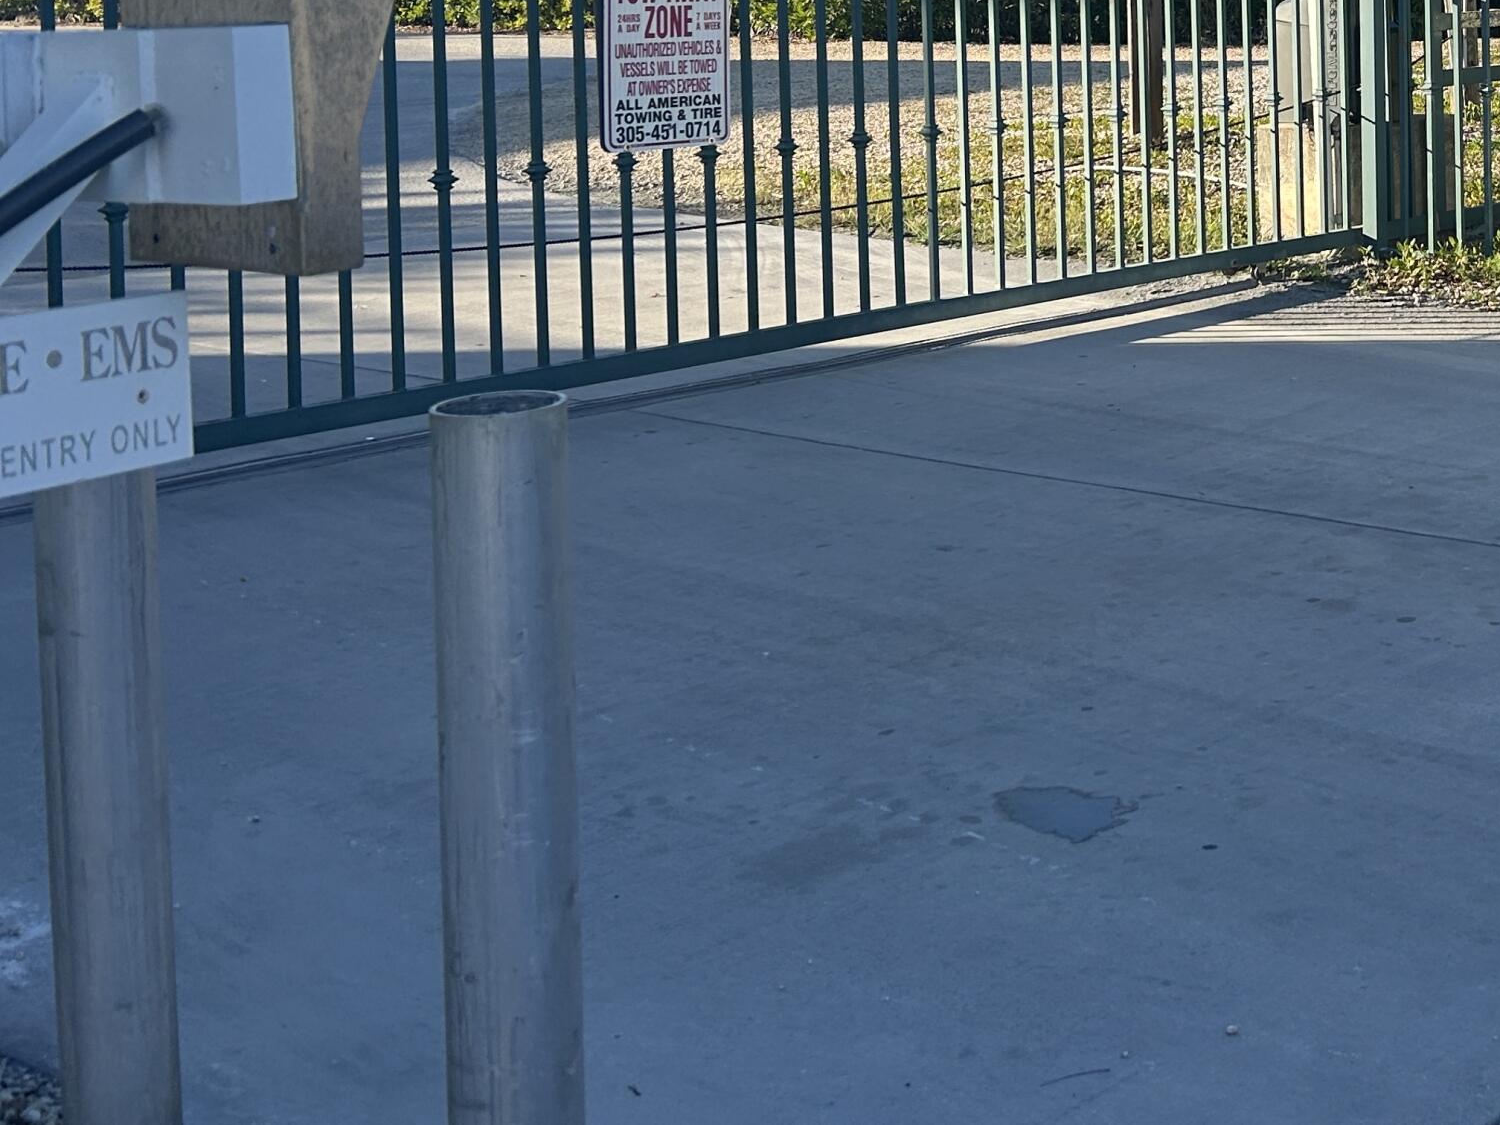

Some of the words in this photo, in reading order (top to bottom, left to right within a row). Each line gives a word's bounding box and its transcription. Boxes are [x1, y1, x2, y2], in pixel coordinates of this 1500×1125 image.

[617, 13, 641, 23] 24HRS
[644, 5, 693, 39] ZONE
[696, 12, 701, 21] 7
[703, 11, 721, 21] DAYS
[617, 24, 623, 33] A
[626, 24, 640, 33] DAY
[696, 22, 701, 30] A
[703, 22, 721, 30] WEEK
[615, 41, 677, 59] UNAUTHORIZED
[678, 39, 715, 56] VEHICLES
[715, 39, 722, 55] &
[620, 61, 656, 78] VESSELS
[656, 60, 677, 76] WILL
[678, 59, 688, 75] BE
[689, 58, 718, 74] TOWED
[627, 81, 637, 96] AT
[638, 78, 676, 96] OWNER'S
[677, 77, 712, 94] EXPENSE
[615, 99, 643, 111] ALL
[647, 93, 721, 109] AMERICAN
[615, 110, 673, 125] TOWING
[677, 108, 687, 121] &
[691, 106, 722, 119] TIRE
[615, 120, 721, 143] 305-451-0714
[80, 316, 178, 382] EMS
[0, 429, 96, 477] ENTRY
[110, 413, 181, 455] ONLY
